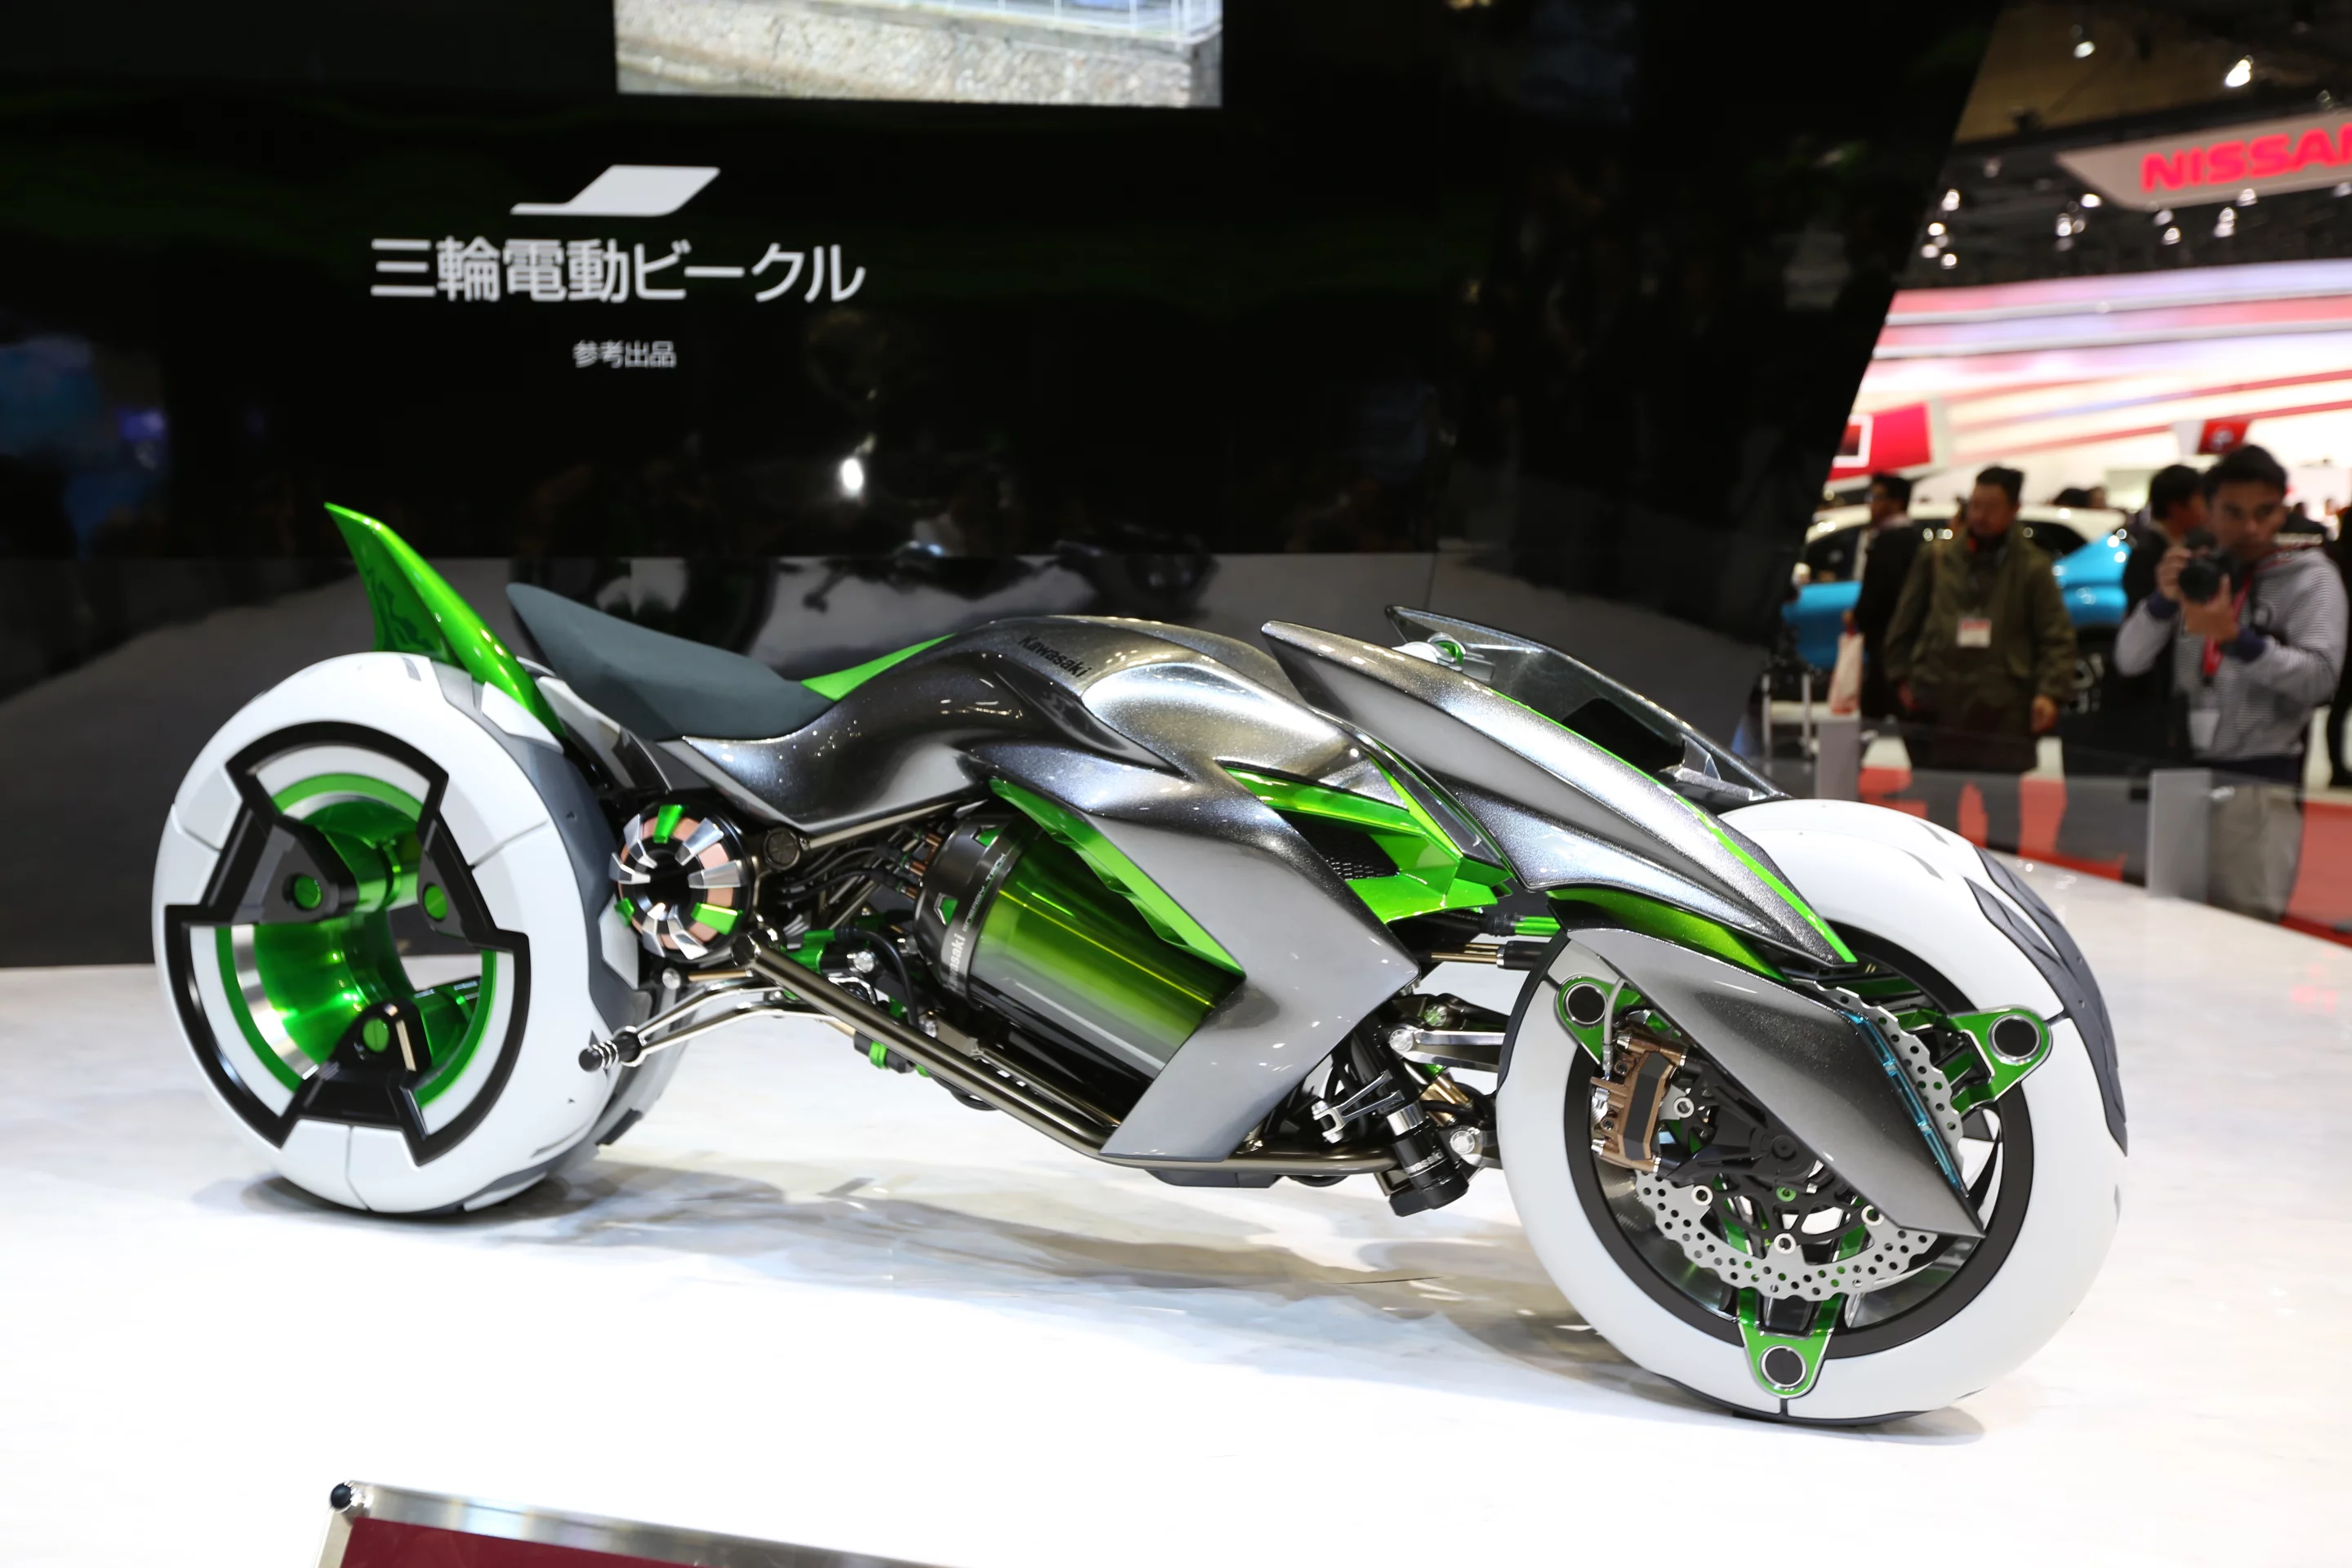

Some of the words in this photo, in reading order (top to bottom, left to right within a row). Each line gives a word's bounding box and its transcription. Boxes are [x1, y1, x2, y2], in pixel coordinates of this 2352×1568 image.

[370, 235, 866, 303] 三輪電動ビークル
[573, 340, 676, 368] 参考出品
[1018, 635, 1093, 678] Kawasaki
